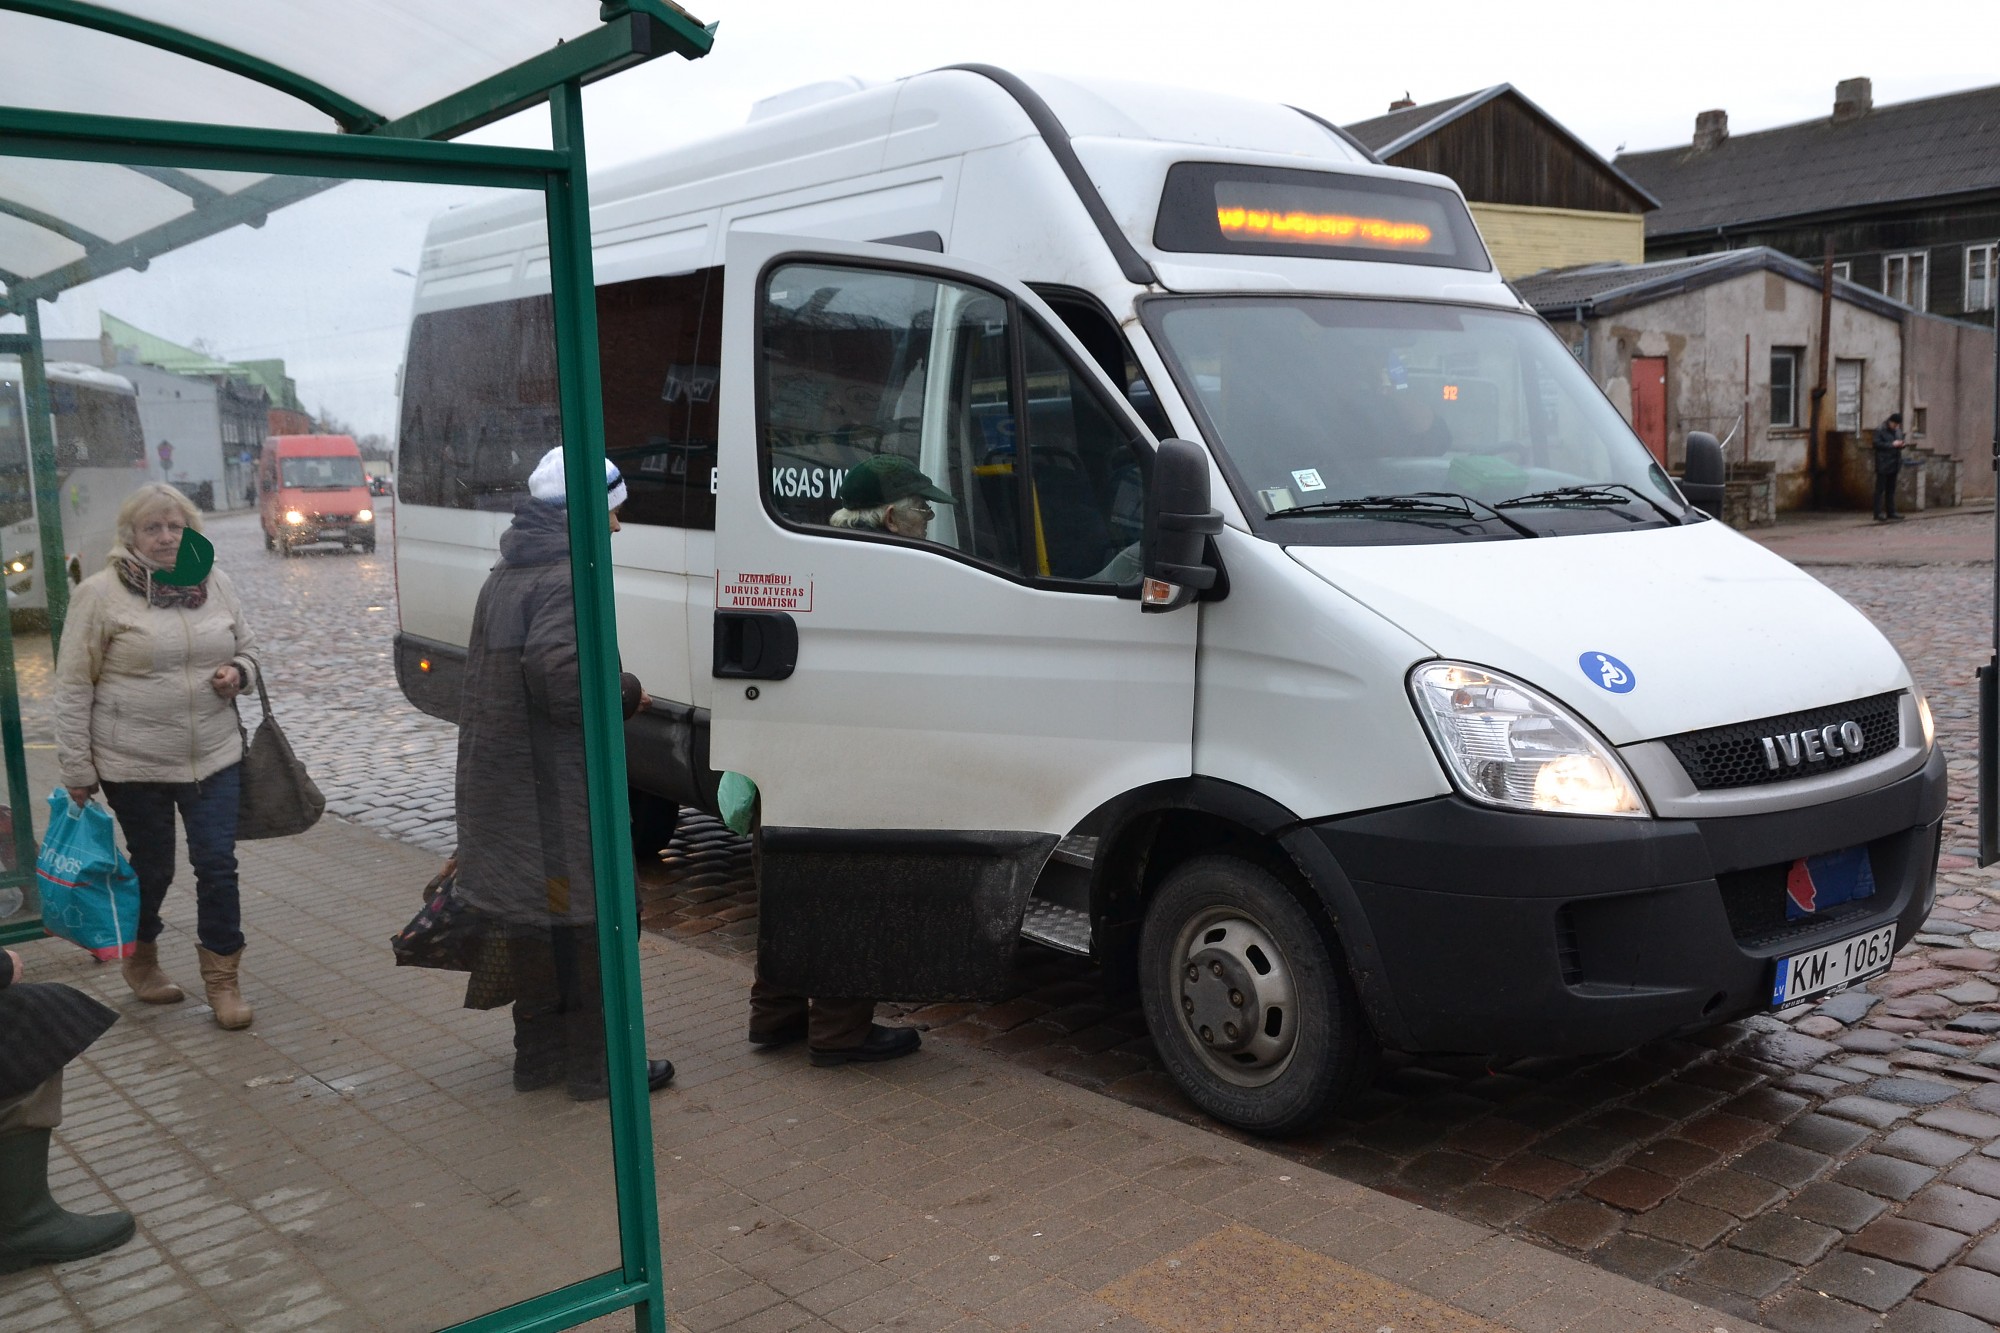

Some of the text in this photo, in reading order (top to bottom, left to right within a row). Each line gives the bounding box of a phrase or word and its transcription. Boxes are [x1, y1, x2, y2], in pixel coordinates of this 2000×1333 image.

[724, 585, 804, 597] DURVIS ATVERAS
[732, 596, 797, 608] AUTOMĀTISKI
[1762, 721, 1864, 770] IVECO
[1791, 929, 1891, 995] KM-1063
[1773, 985, 1785, 997] LV
